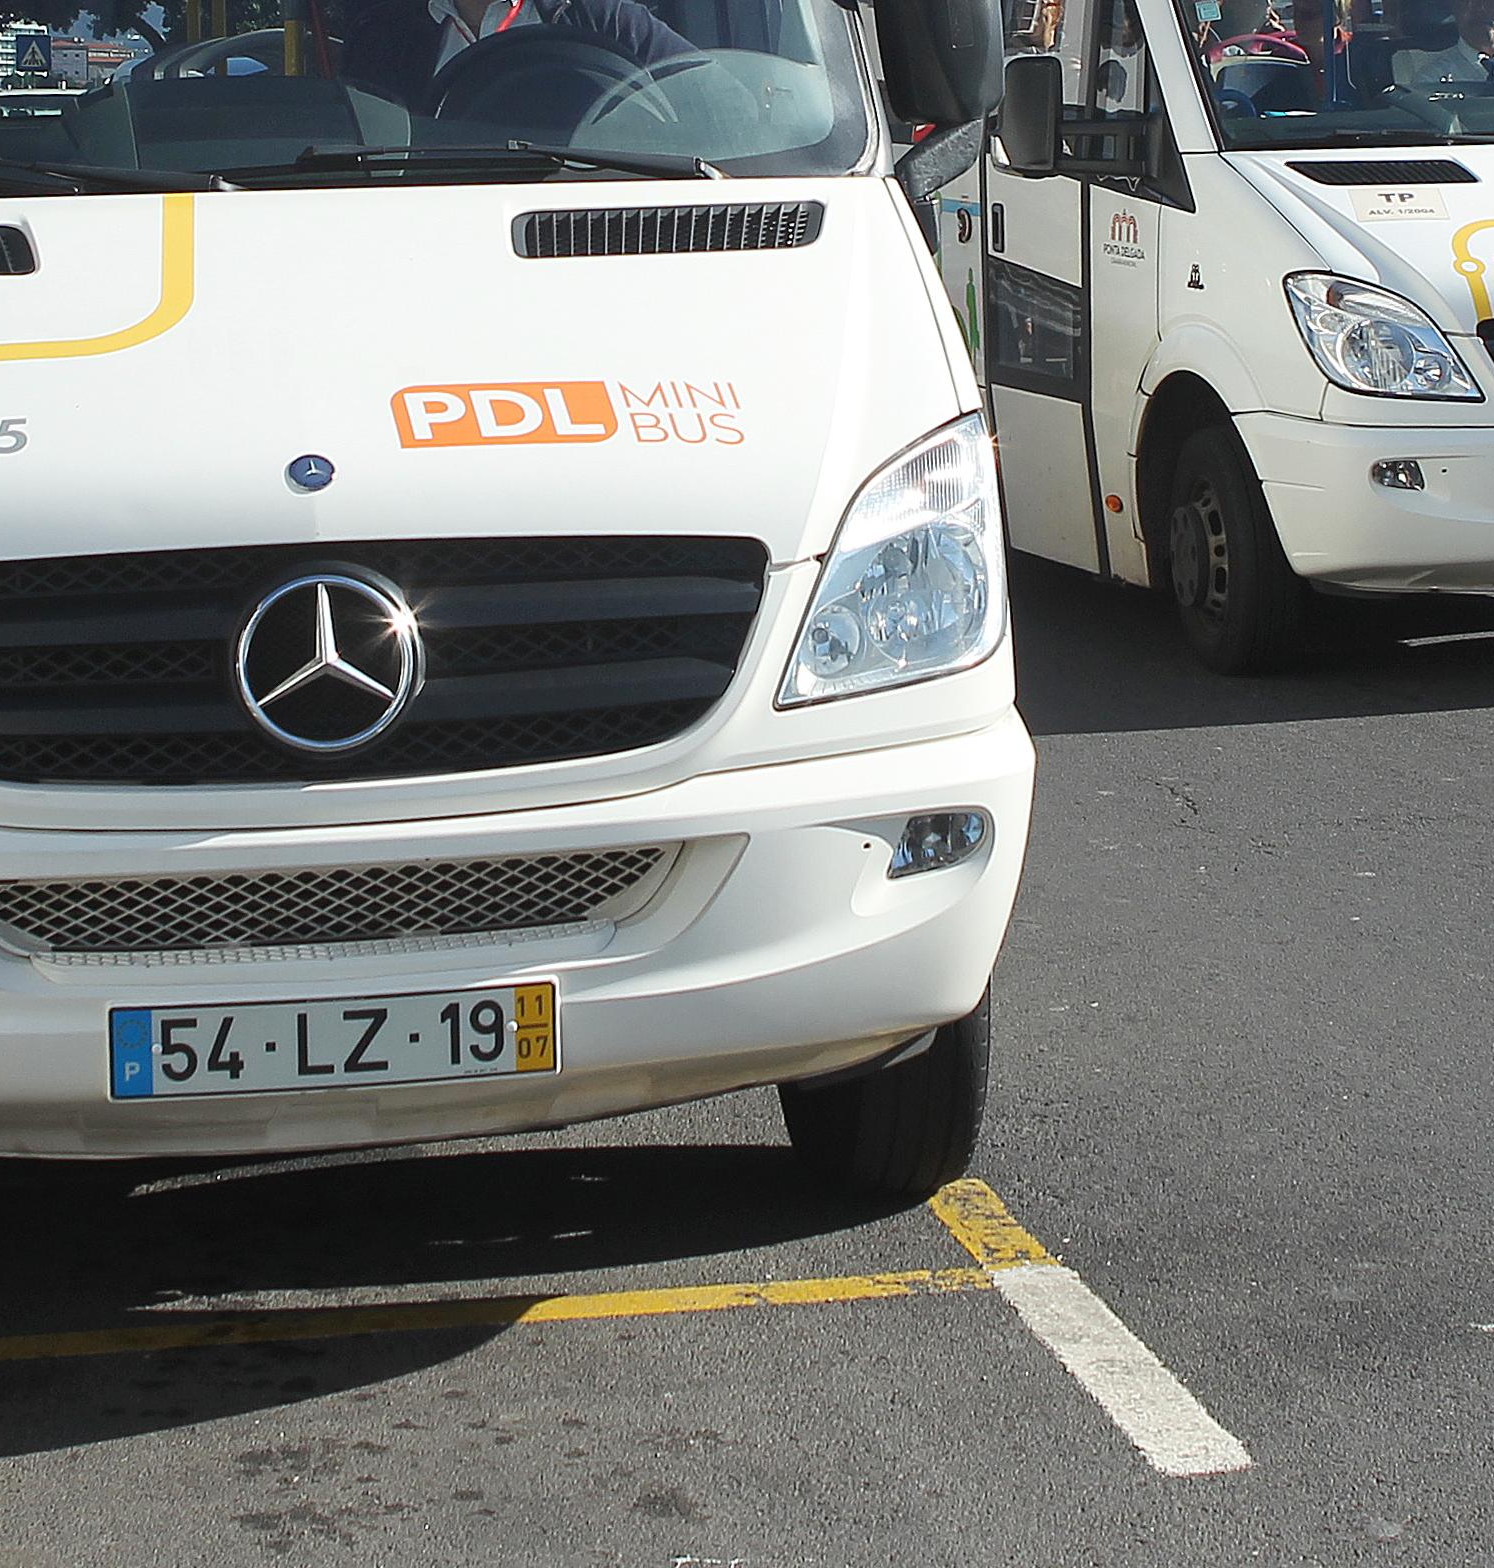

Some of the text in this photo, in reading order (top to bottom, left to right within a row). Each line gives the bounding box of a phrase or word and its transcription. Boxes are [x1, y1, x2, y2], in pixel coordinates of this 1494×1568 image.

[1377, 193, 1415, 203] TP
[617, 380, 741, 409] MINI
[403, 388, 607, 441] PDL
[630, 412, 745, 446] BUS
[124, 1062, 140, 1082] P
[517, 994, 545, 1018] 11
[517, 1036, 549, 1060] 07
